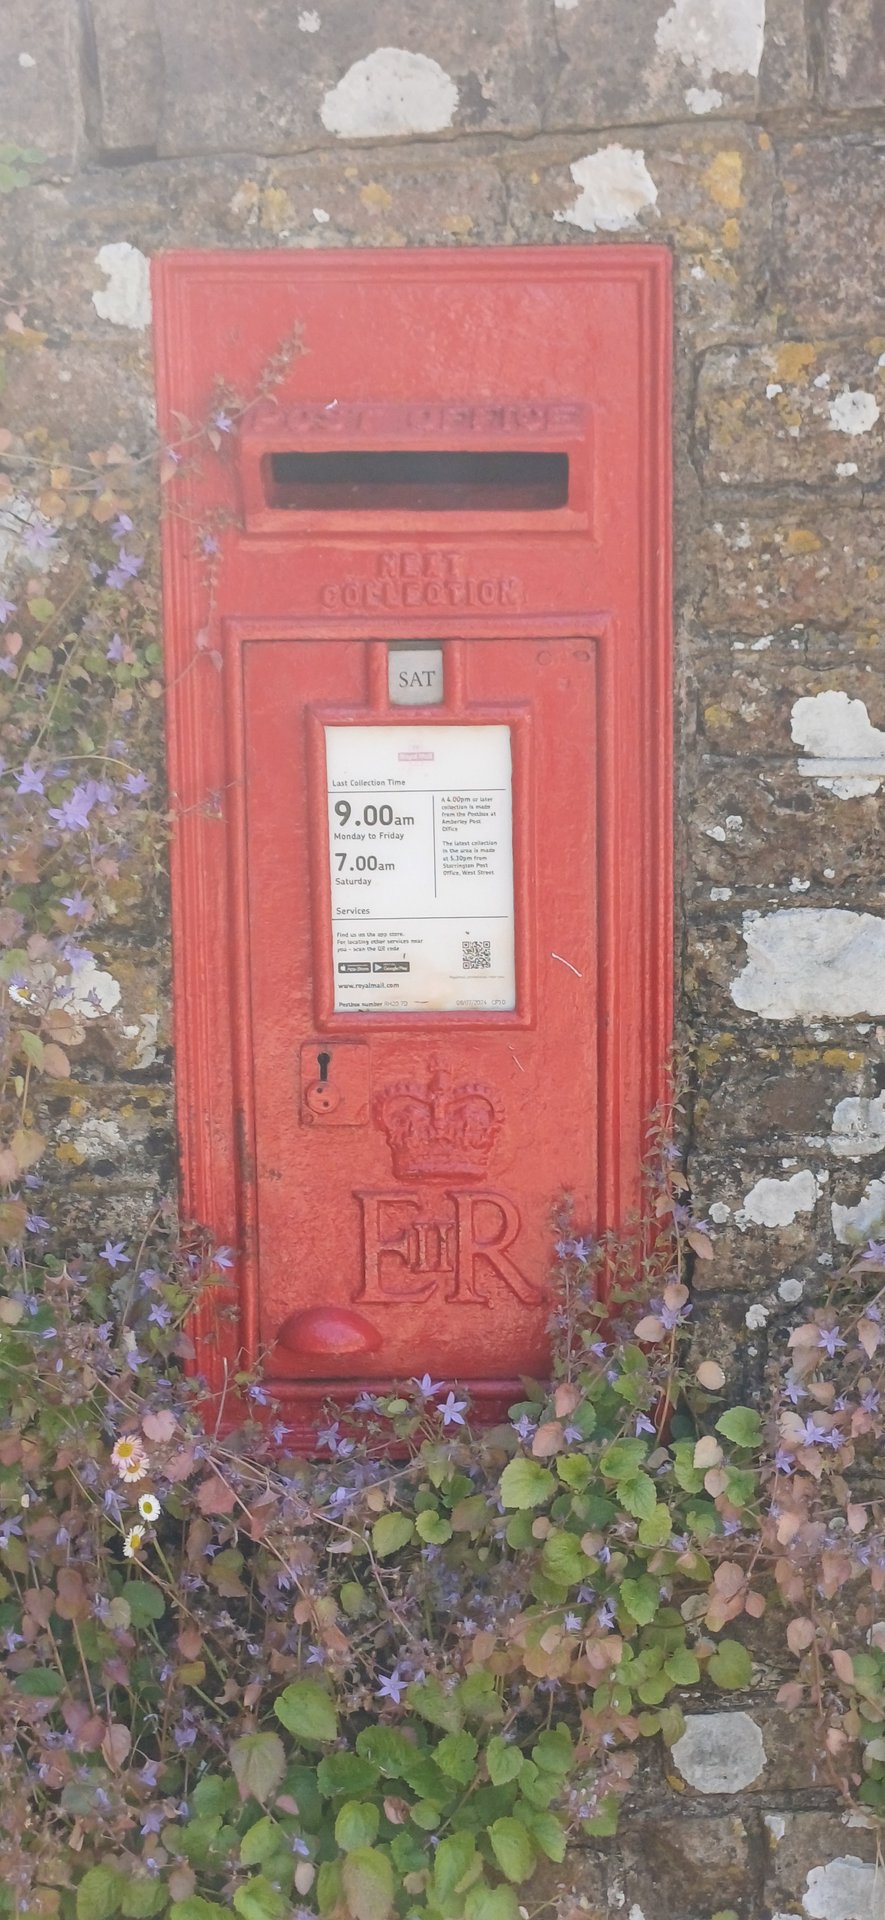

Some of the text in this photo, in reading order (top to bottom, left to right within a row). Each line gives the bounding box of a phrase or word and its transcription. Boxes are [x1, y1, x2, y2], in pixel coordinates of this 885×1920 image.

[252, 405, 581, 432] POST OFFICE
[376, 551, 463, 579] NEXT
[320, 577, 524, 608] COLLECTION
[399, 670, 436, 688] SAT
[332, 778, 406, 787] Last Collection Time
[334, 799, 415, 827] 9.00am
[334, 831, 405, 841] Monday to Friday
[334, 852, 396, 872] 7.00am
[335, 877, 372, 887] Saturday
[335, 906, 371, 916] Services
[347, 938, 369, 946] locating
[337, 982, 400, 990] www.royalmail.com
